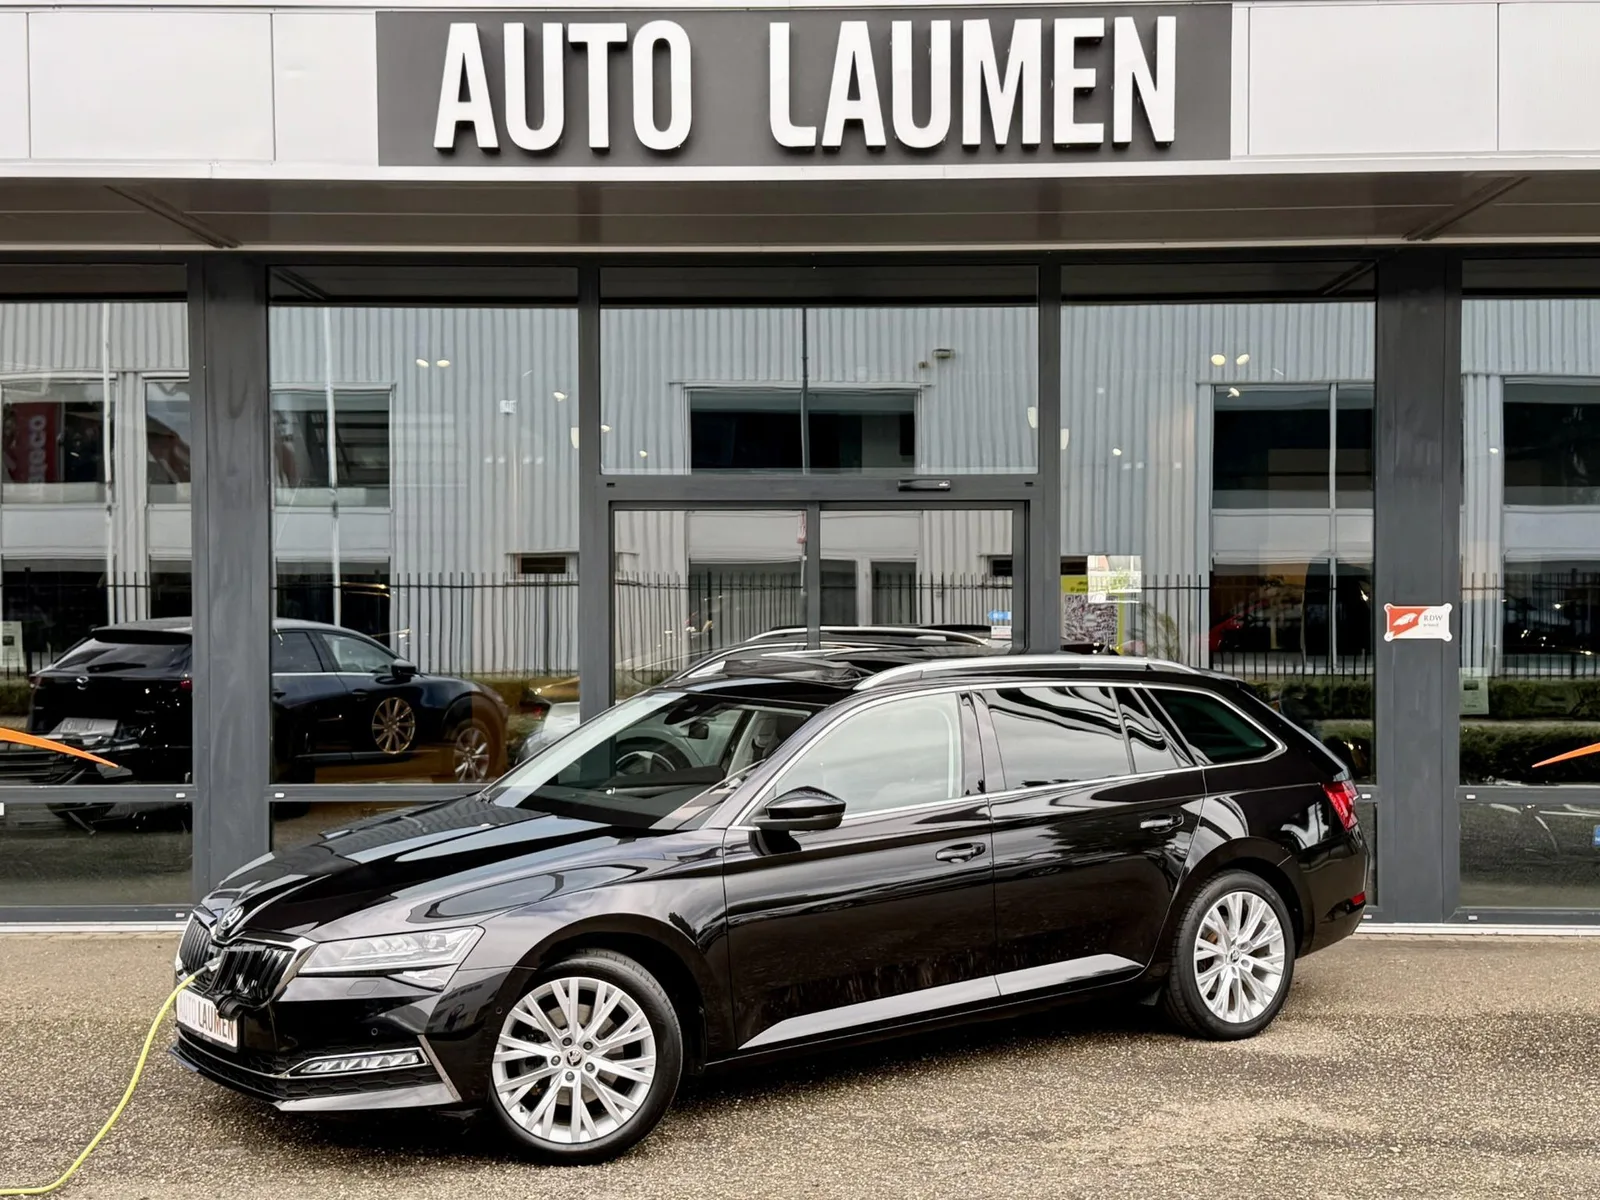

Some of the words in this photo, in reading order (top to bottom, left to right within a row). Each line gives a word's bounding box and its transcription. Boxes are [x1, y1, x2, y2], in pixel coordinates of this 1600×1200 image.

[433, 20, 693, 151] AUTO
[769, 16, 1177, 149] LAUMEN
[198, 1000, 235, 1041] LAUMEN
